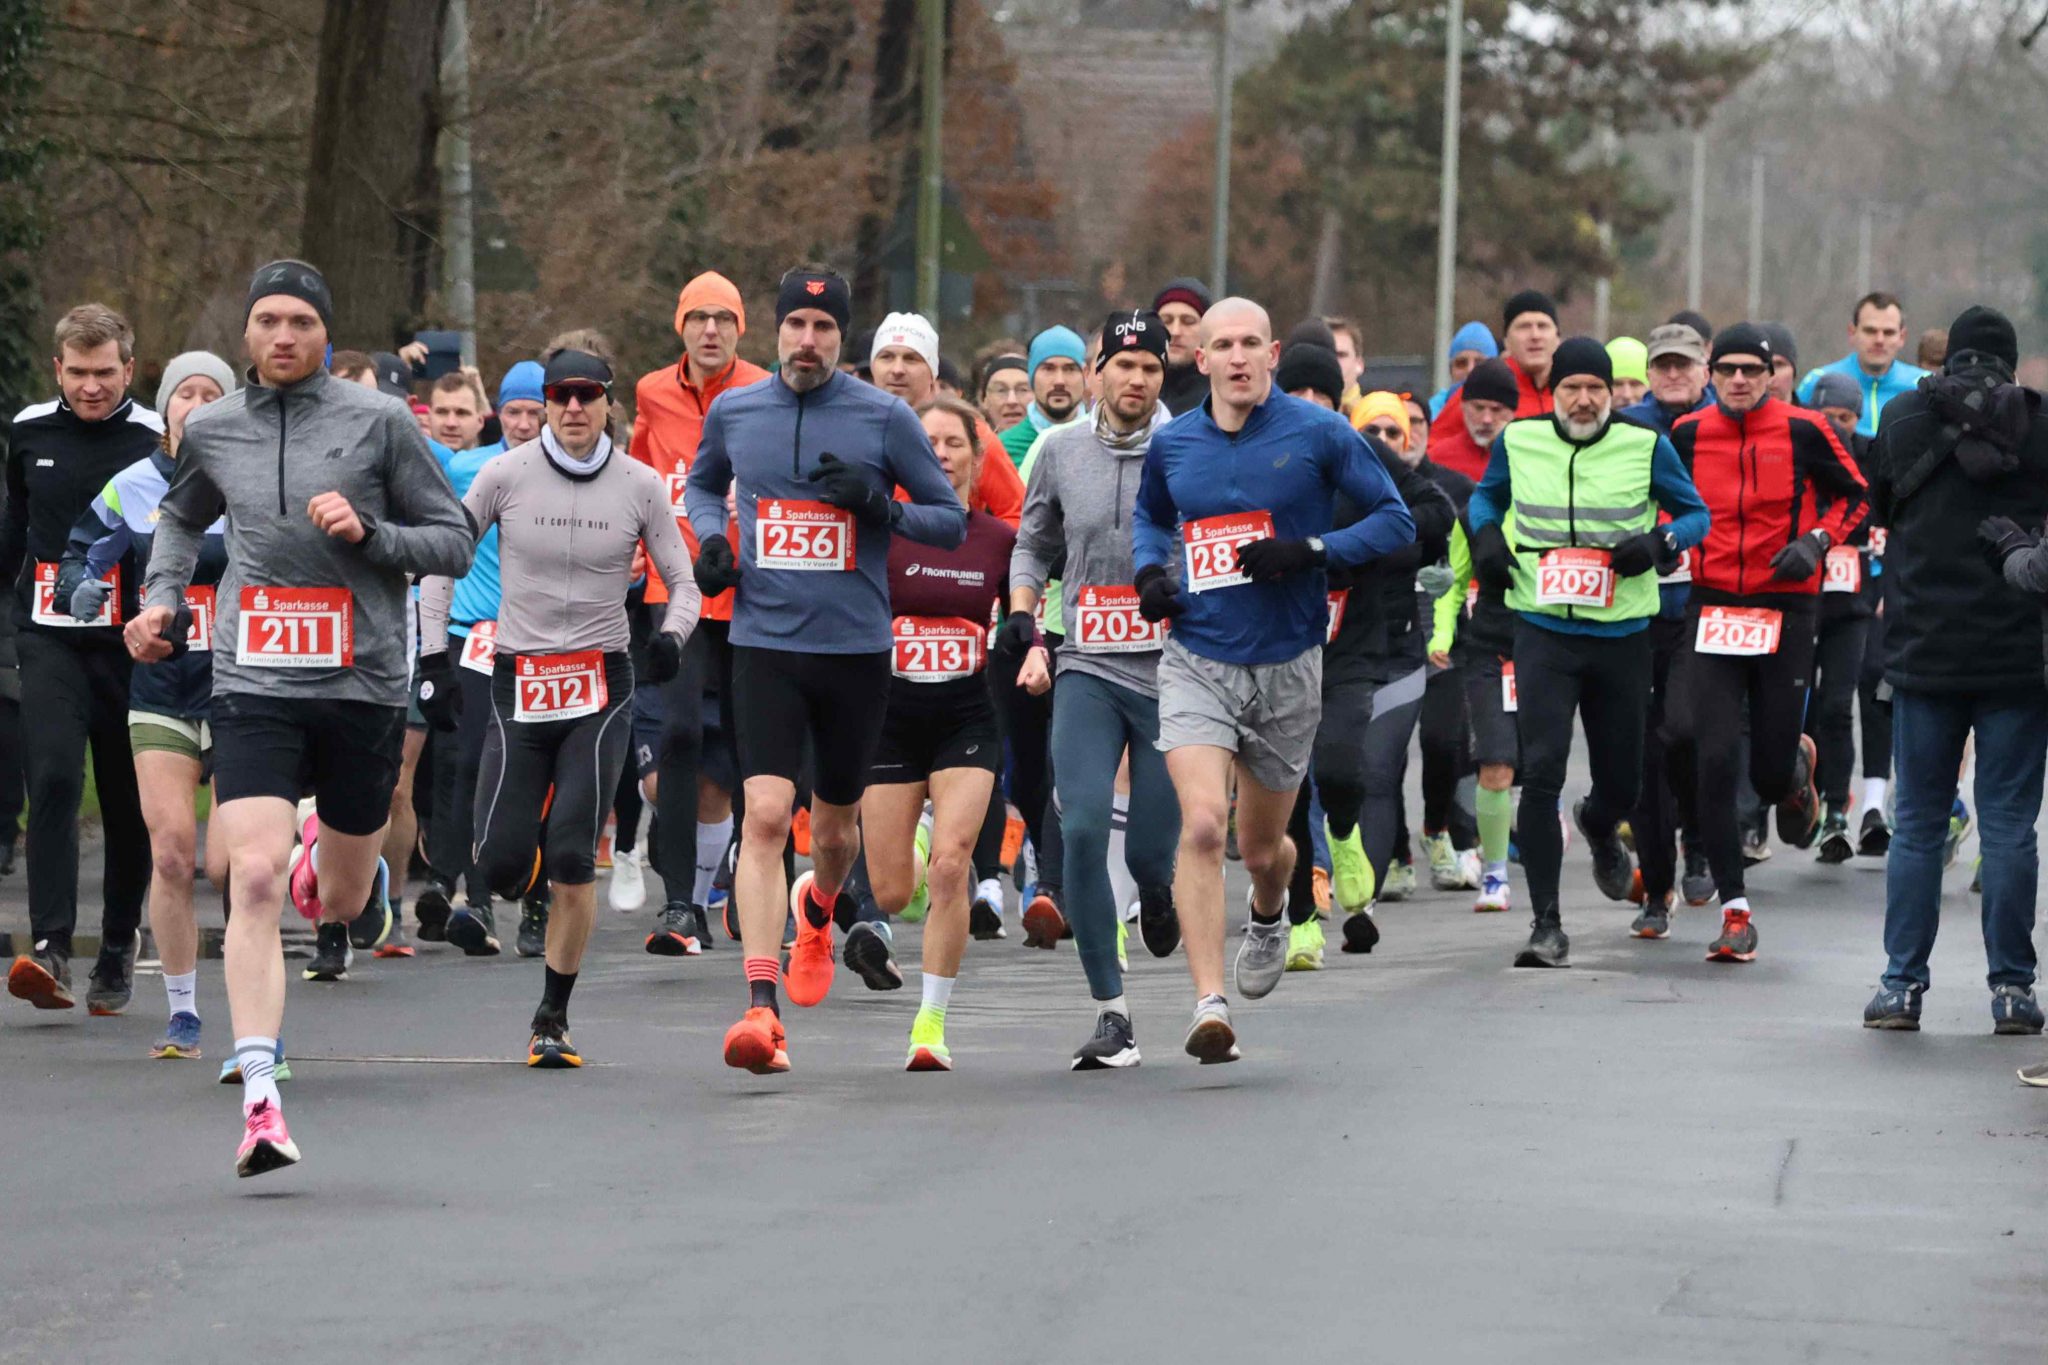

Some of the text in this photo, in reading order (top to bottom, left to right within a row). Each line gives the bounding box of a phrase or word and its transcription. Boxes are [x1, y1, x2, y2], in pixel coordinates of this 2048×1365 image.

[1115, 309, 1146, 335] DNB
[535, 517, 545, 525] LE
[588, 521, 608, 530] RIDE
[786, 509, 836, 521] Sparkasse
[768, 525, 834, 557] 256
[1205, 523, 1253, 538] Sparkasse
[1194, 538, 1252, 578] 28
[922, 567, 984, 580] FRONTRUNNER
[1545, 569, 1600, 595] 209
[273, 600, 329, 612] Sparkasse
[261, 617, 318, 653] 211
[919, 625, 966, 636] Sparkasse
[1085, 611, 1150, 641] 205
[1708, 623, 1763, 648] 204
[904, 640, 962, 671] 213
[539, 662, 586, 675] Sparkasse
[527, 678, 585, 711] 212
